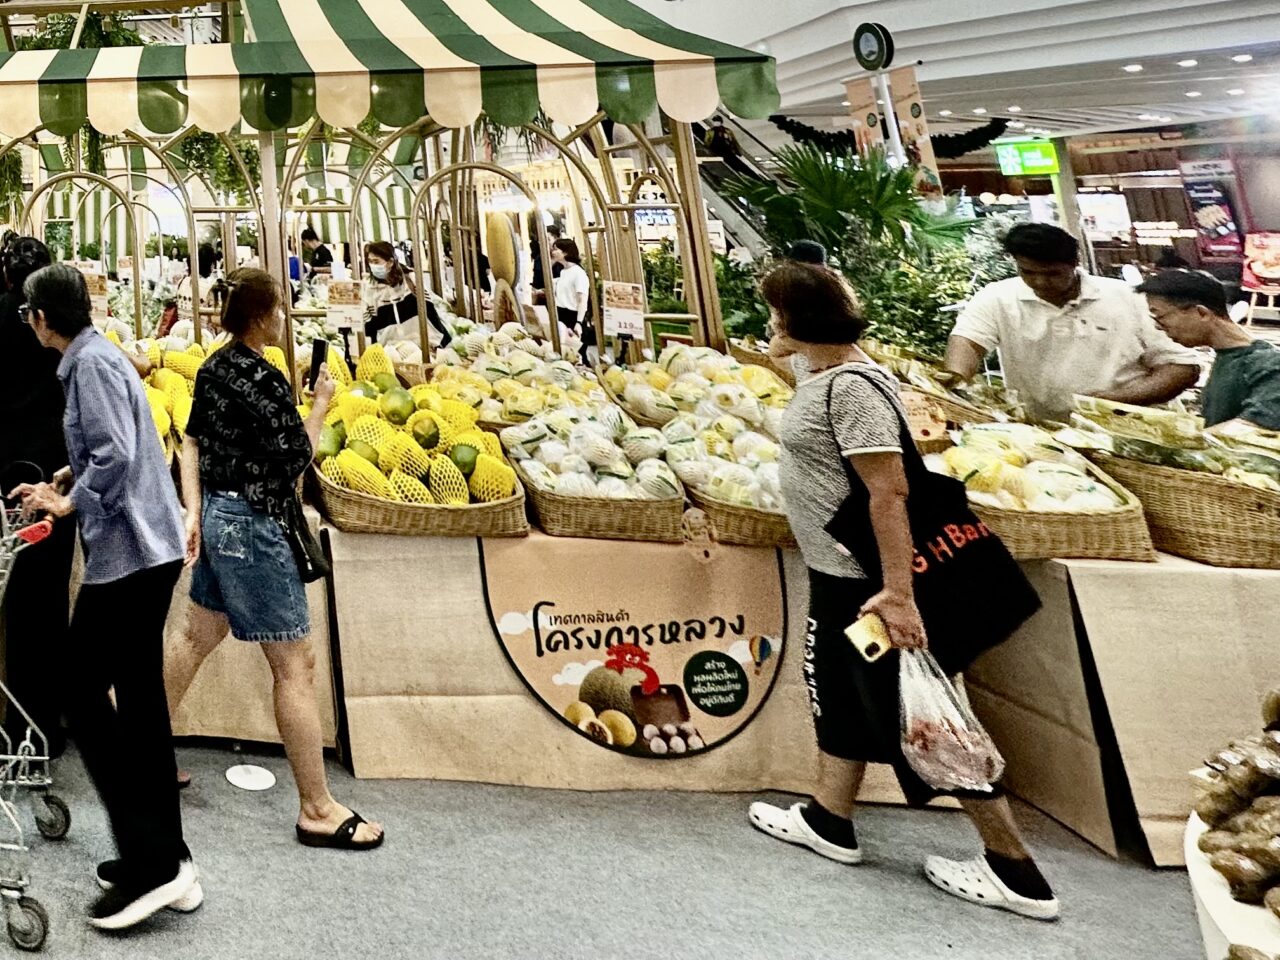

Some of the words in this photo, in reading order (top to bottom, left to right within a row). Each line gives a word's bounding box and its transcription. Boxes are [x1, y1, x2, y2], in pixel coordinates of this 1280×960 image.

[944, 522, 989, 548] Ban
[532, 601, 746, 657] โครงการหลวง
[549, 609, 630, 626] เทศกาลสินค้า
